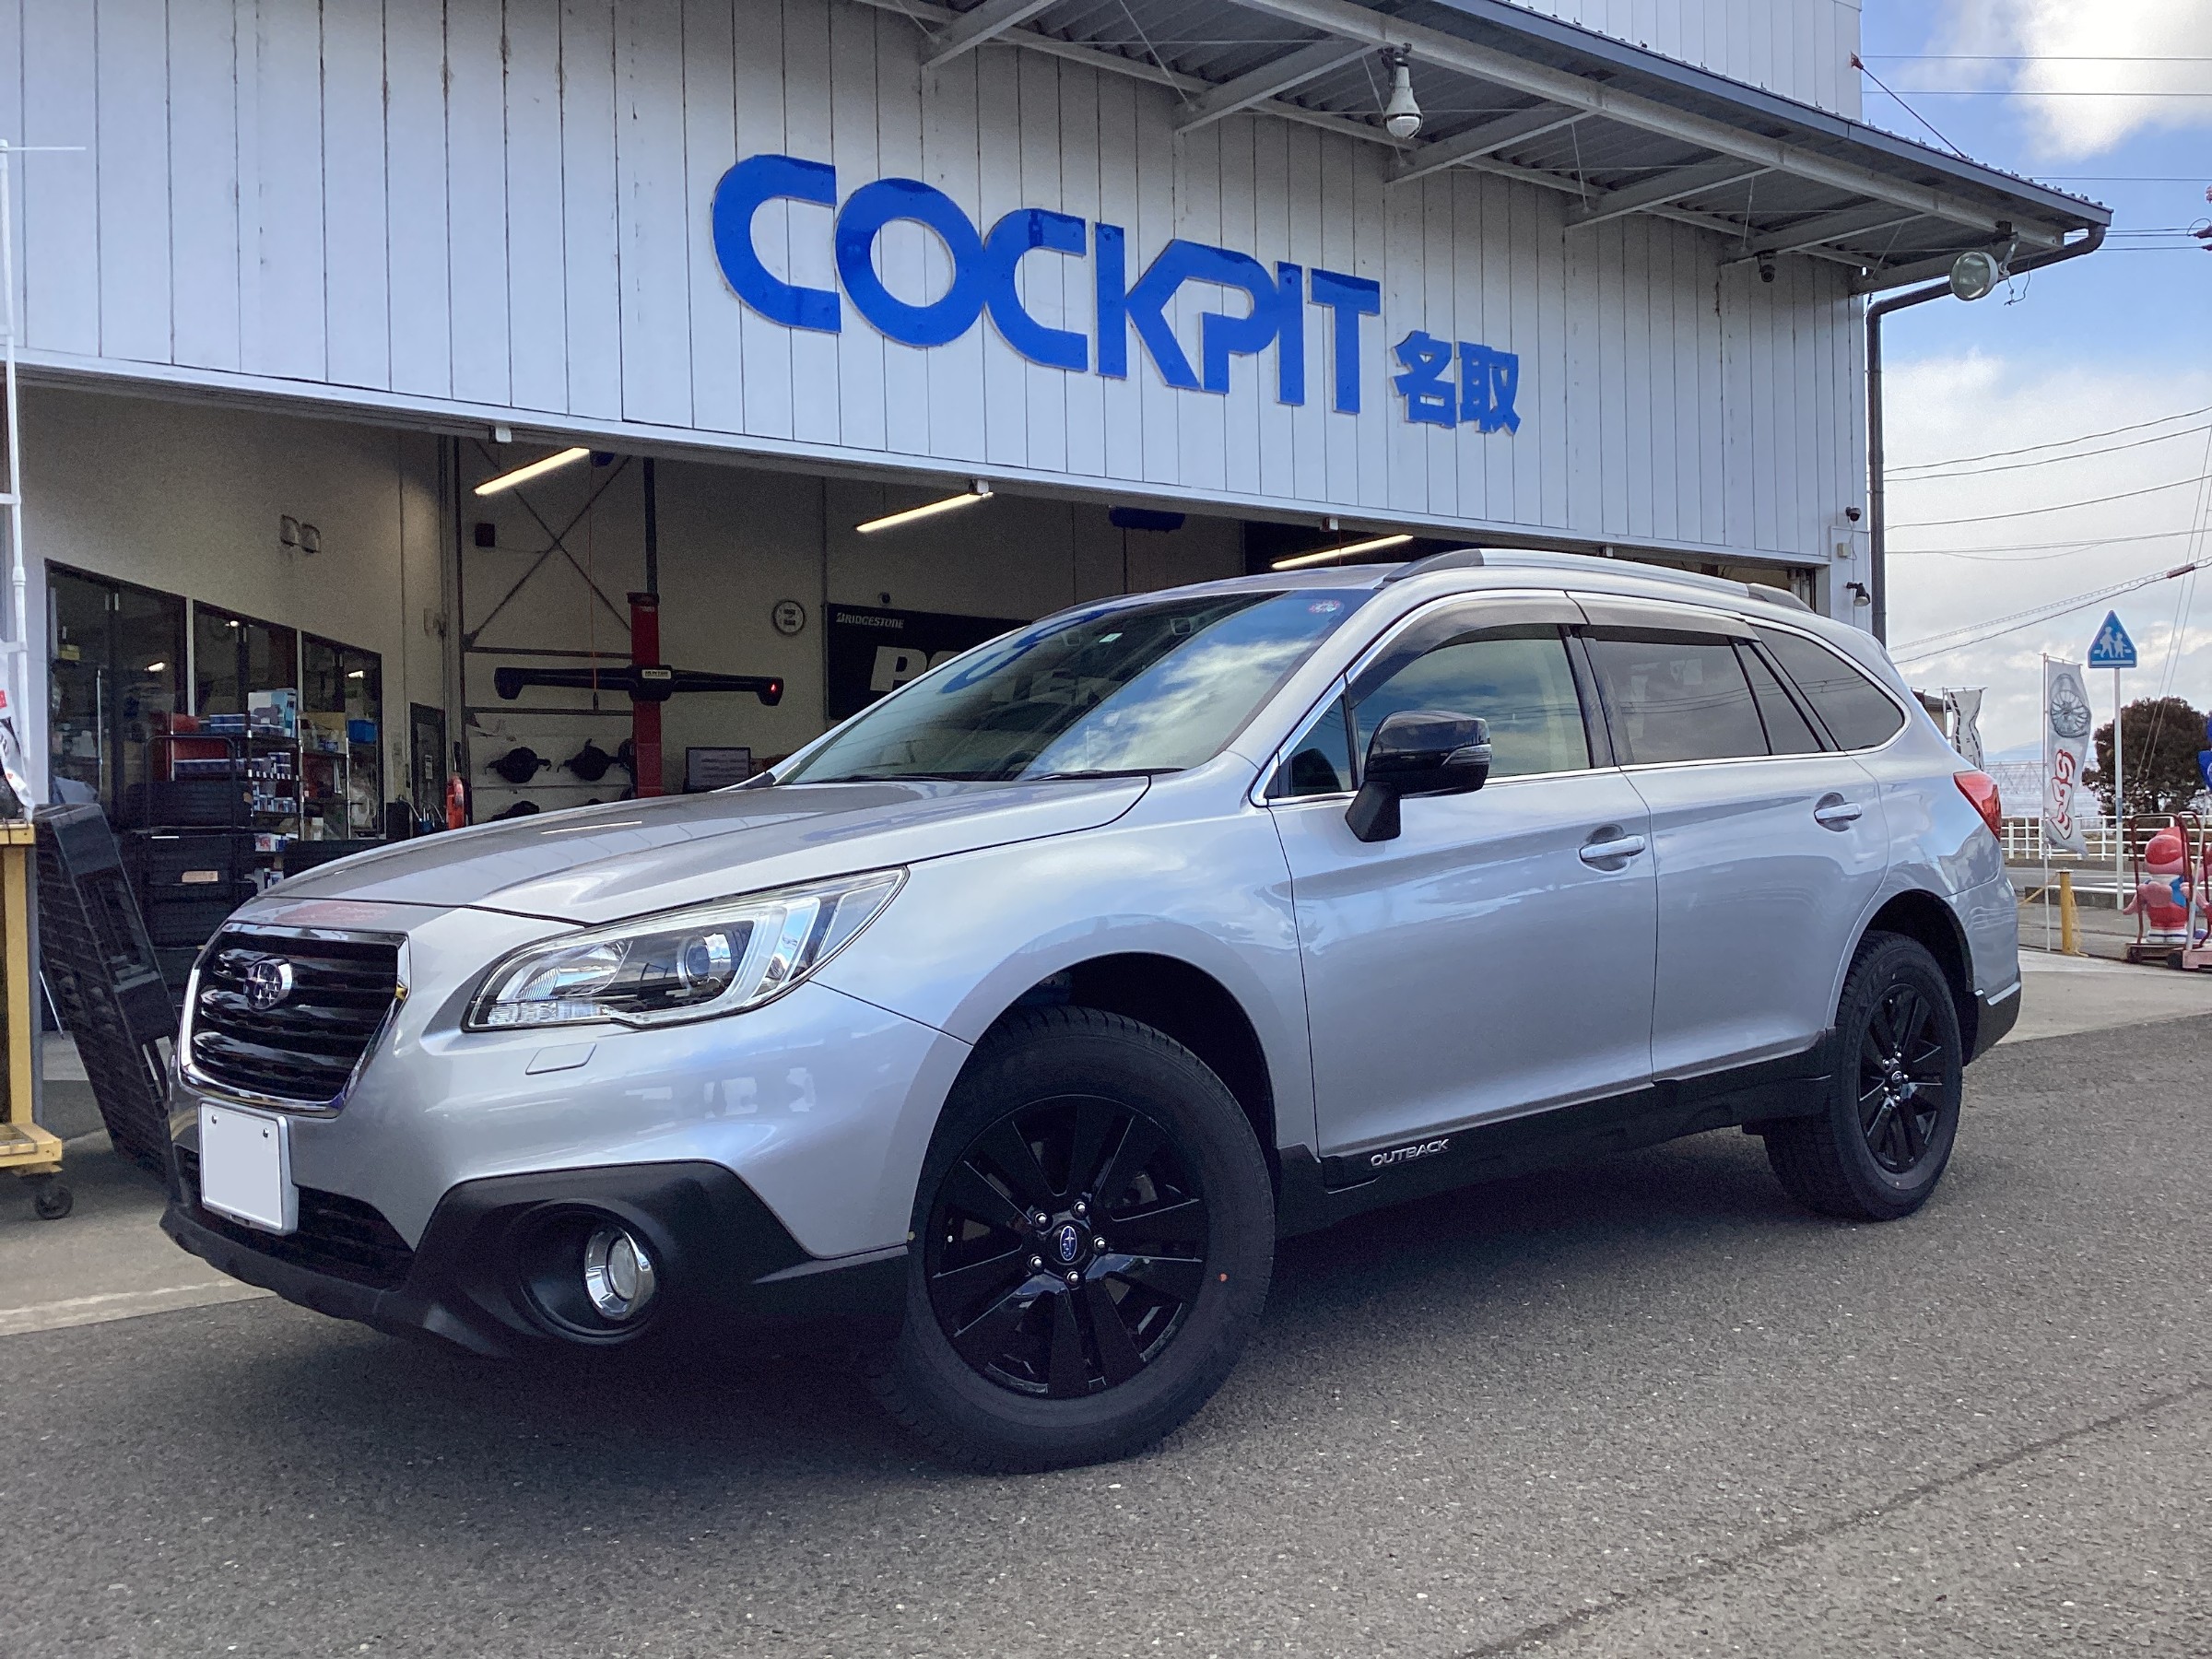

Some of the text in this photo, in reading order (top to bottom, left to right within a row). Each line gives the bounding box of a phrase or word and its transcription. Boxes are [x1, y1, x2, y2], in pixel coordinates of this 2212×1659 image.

[712, 154, 1521, 436] COCKPIT 名取
[835, 611, 905, 629] BRIDGESTONE
[1371, 1138, 1450, 1167] OUTBACK
